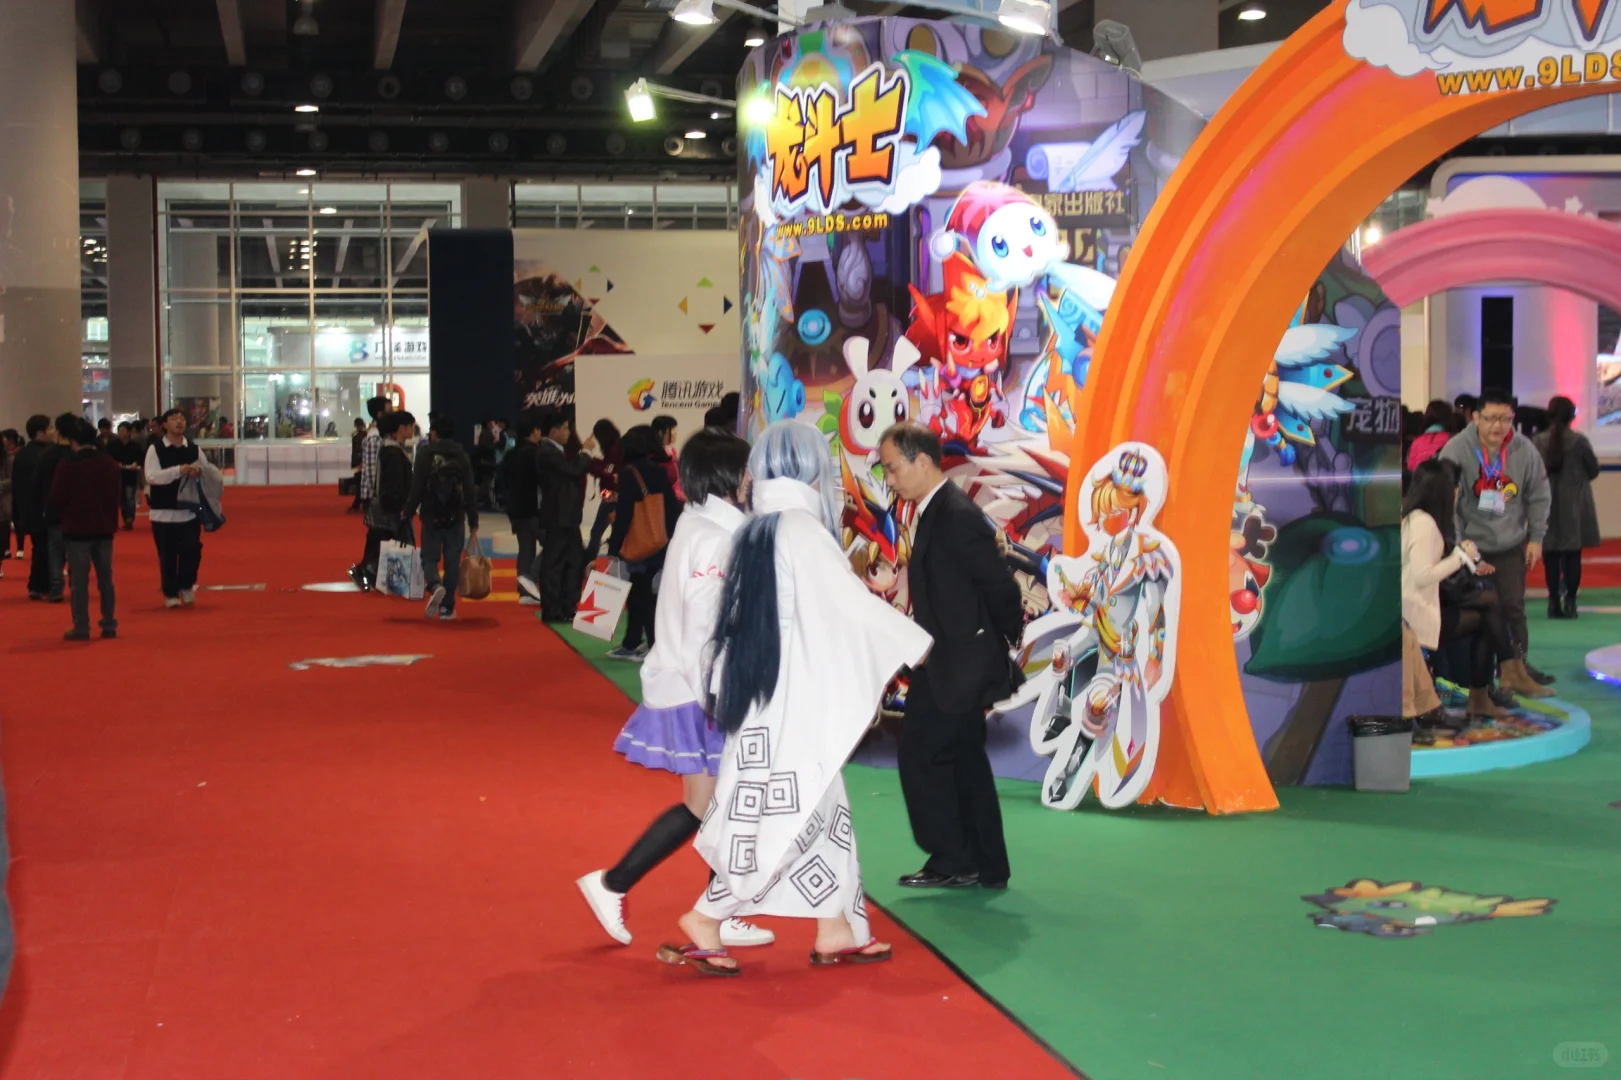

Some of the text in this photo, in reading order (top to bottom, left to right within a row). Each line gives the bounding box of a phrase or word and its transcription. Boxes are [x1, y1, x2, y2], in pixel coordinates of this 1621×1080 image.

[768, 75, 905, 204] 龙斗士
[1027, 190, 1126, 217] 家出版社
[776, 213, 889, 238] www.9LDS.com
[661, 379, 723, 399] 腾讯游戏
[1345, 397, 1400, 433] 宠物
